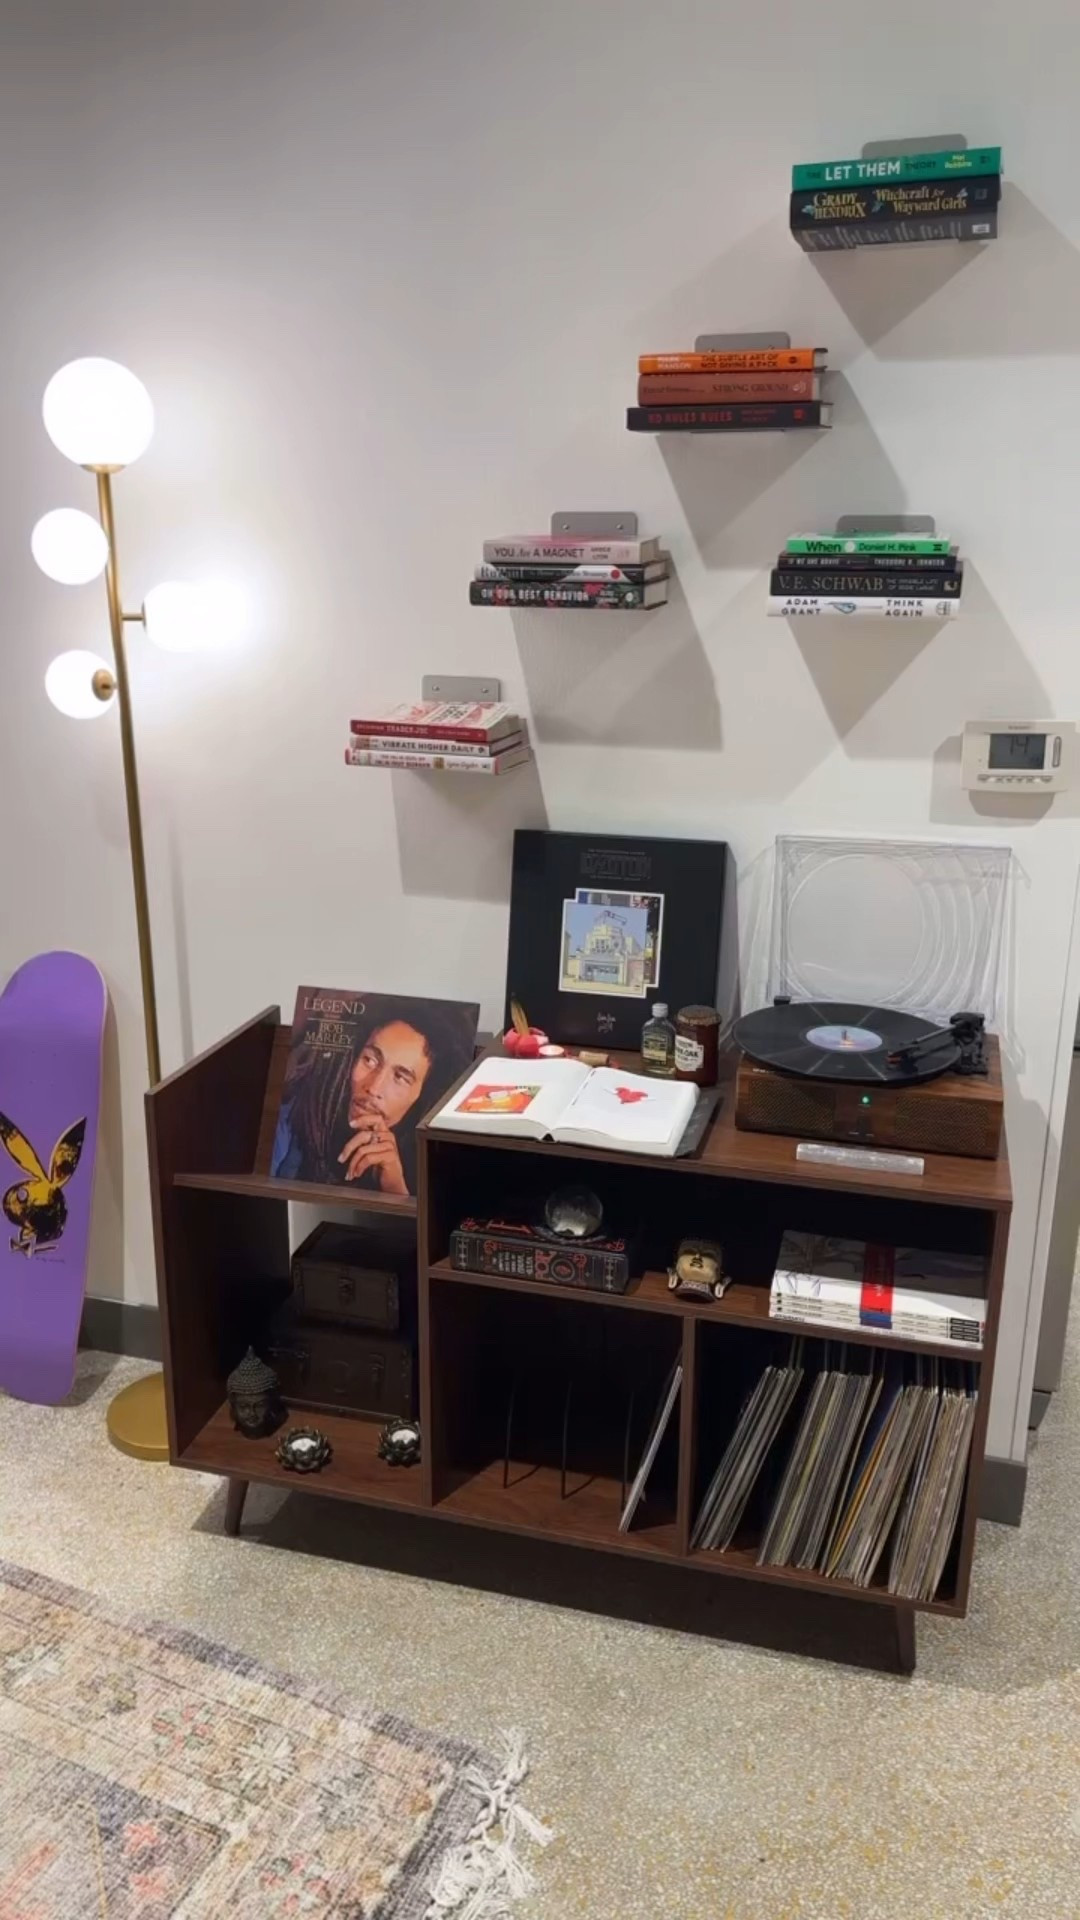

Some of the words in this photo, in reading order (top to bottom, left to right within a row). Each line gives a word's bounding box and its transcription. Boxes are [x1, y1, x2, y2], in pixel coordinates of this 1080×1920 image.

[825, 165, 852, 181] LET
[856, 160, 900, 178] THEM
[814, 192, 858, 206] GRADY
[875, 186, 929, 201] Witchcraft
[814, 202, 867, 219] HENDRIX
[893, 200, 941, 214] Wayward
[941, 197, 967, 210] Girls
[494, 547, 514, 558] YOU
[533, 547, 540, 557] A
[542, 547, 585, 558] MAGNET
[805, 541, 841, 552] When
[859, 542, 886, 551] Daniel
[898, 542, 916, 551] Pink
[812, 575, 883, 591] SCHWAB
[518, 589, 540, 600] BEST
[544, 590, 589, 601] BEHAVIOR
[887, 599, 923, 607] THINK
[781, 608, 821, 616] GRANT
[885, 608, 923, 617] AGAIN
[382, 741, 416, 750] VIBRATE
[418, 743, 449, 752] HIGHER
[451, 745, 474, 753] DAILY
[303, 996, 366, 1015] LEGEND
[320, 1022, 344, 1033] BOB
[304, 1031, 354, 1044] MARLEY
